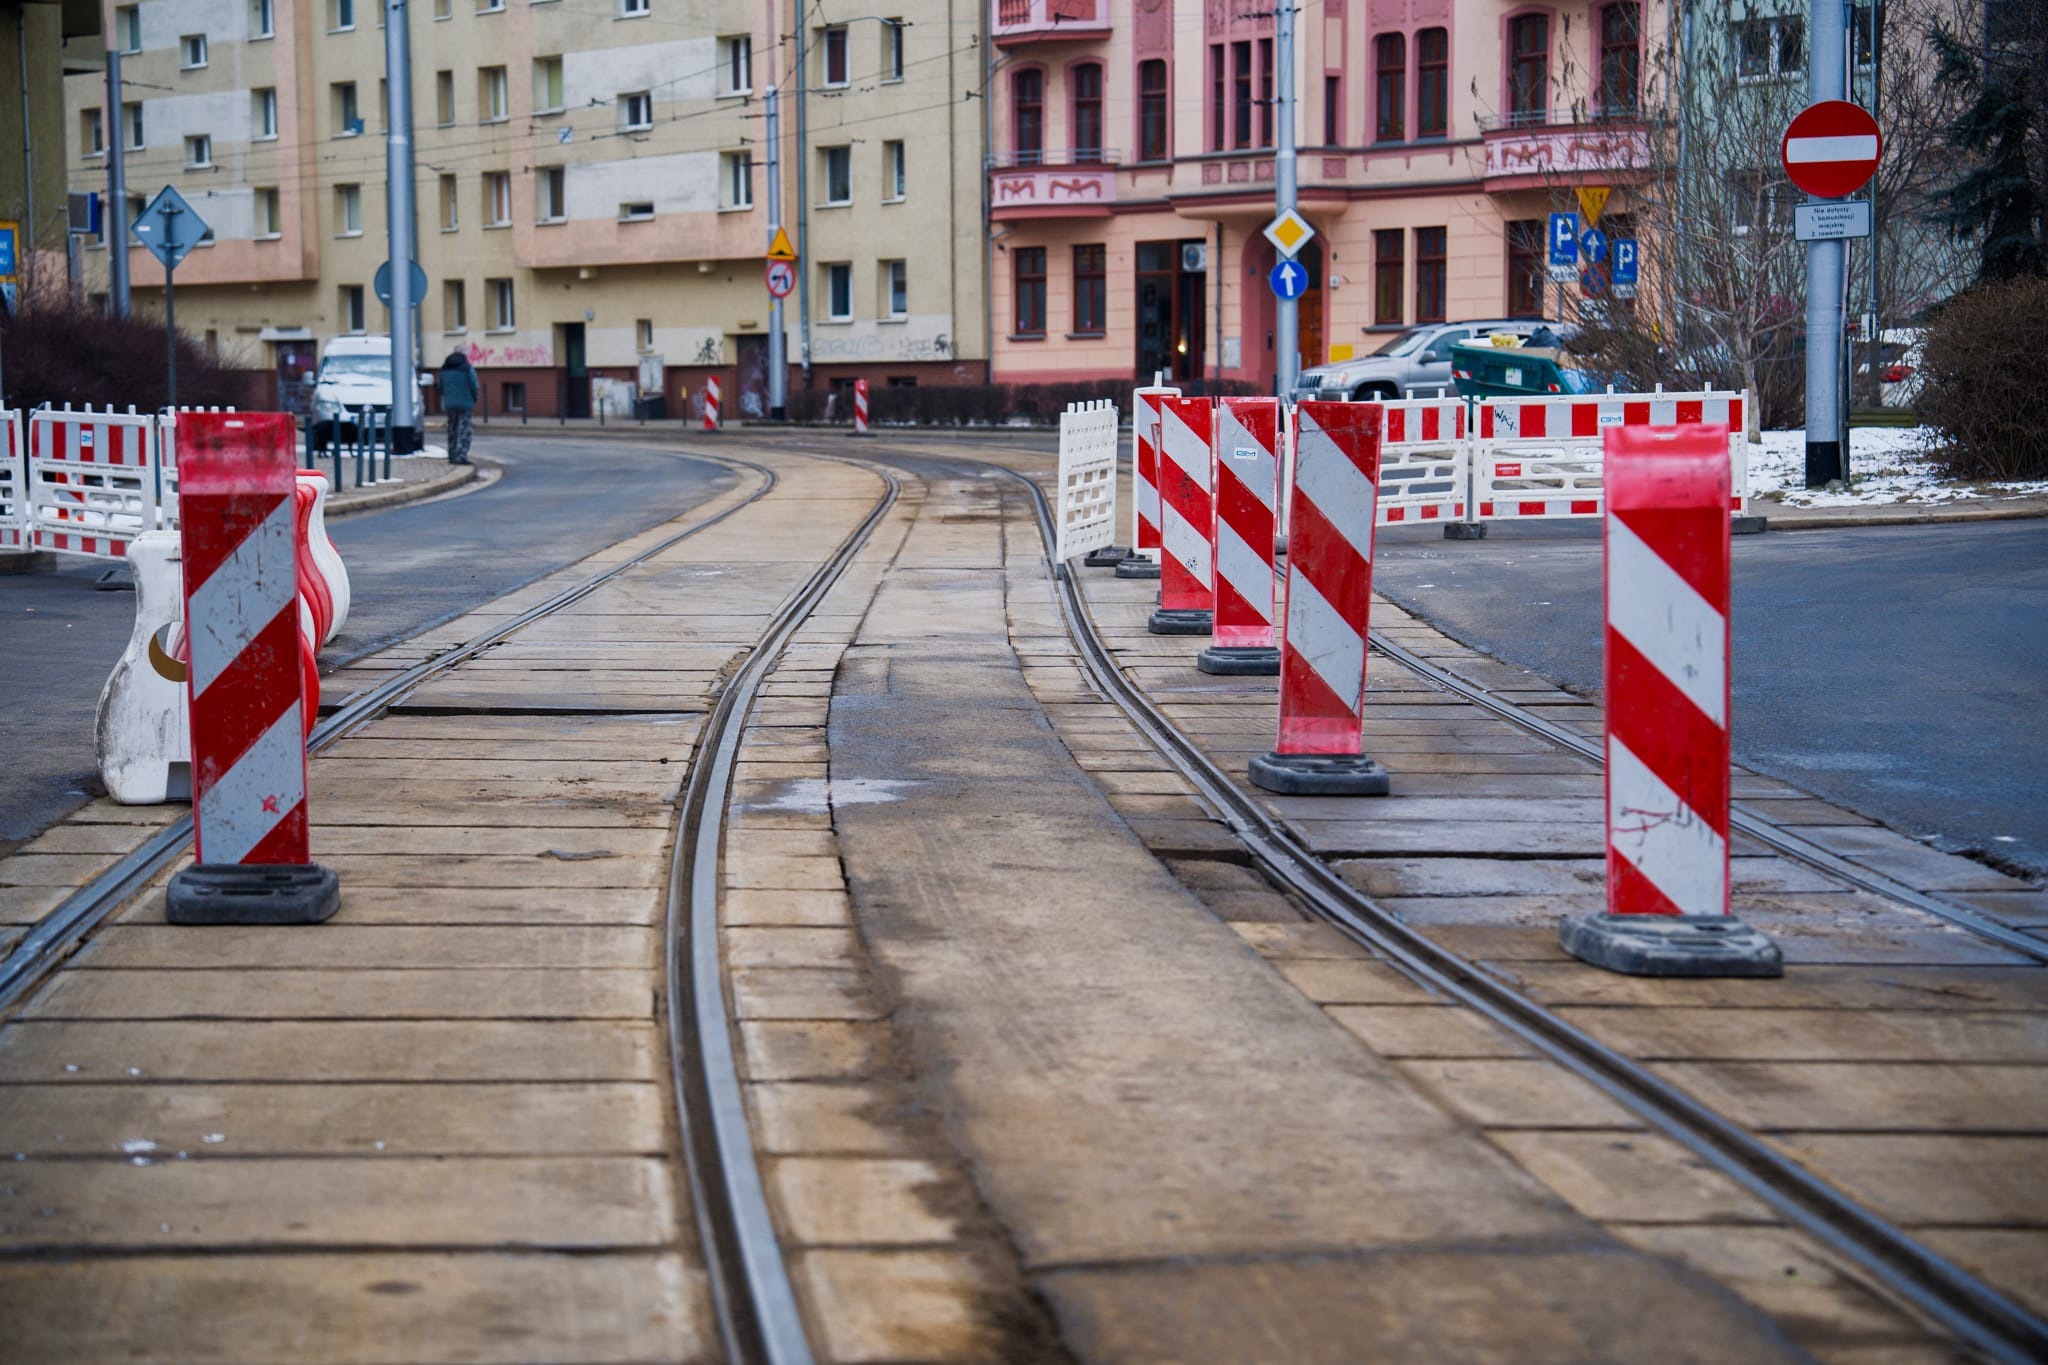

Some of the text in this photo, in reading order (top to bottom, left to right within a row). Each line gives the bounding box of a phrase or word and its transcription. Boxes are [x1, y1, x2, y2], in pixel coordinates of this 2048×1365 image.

[1818, 213, 1855, 221] komunikacji
[1818, 222, 1845, 230] miejskiej
[1557, 217, 1573, 250] P
[1618, 243, 1633, 271] P
